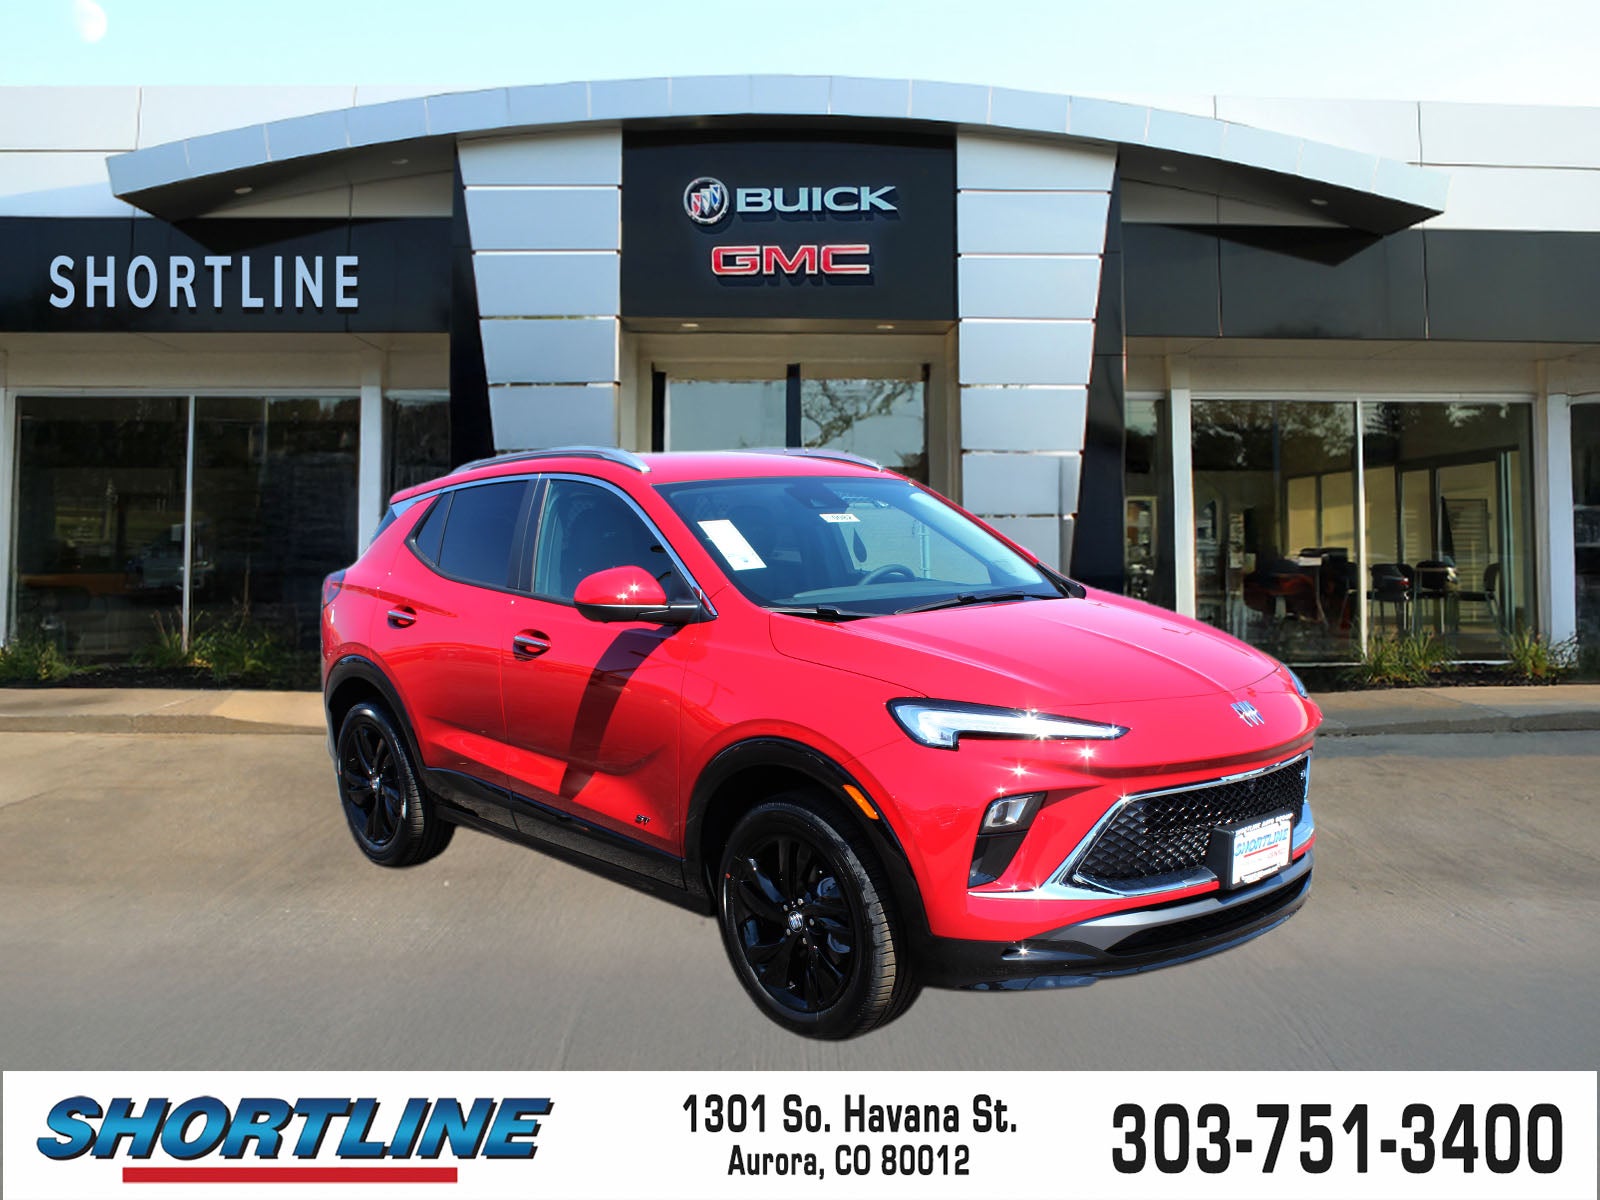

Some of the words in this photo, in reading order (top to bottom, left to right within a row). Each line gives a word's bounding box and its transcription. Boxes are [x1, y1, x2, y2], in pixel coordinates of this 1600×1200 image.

[736, 186, 898, 213] BUICK
[711, 244, 870, 275] GMC
[49, 255, 359, 309] SHORTLINE
[1234, 827, 1290, 857] SHORTLINE
